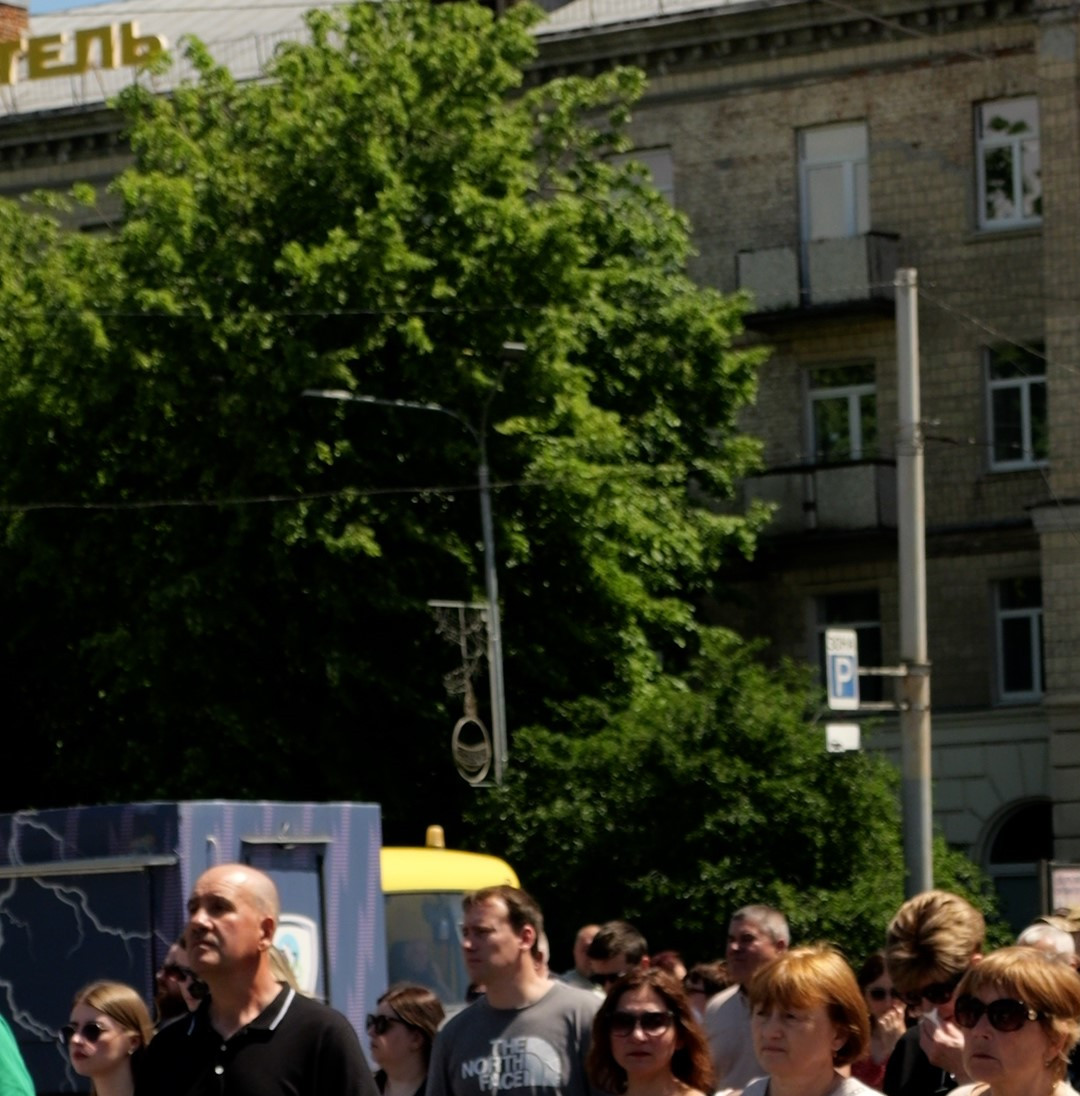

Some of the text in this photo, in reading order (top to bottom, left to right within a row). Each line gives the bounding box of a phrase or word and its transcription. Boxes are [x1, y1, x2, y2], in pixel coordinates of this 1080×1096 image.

[489, 1038, 528, 1058] THE
[461, 1053, 525, 1080] NORTH
[479, 1069, 526, 1092] FACE
